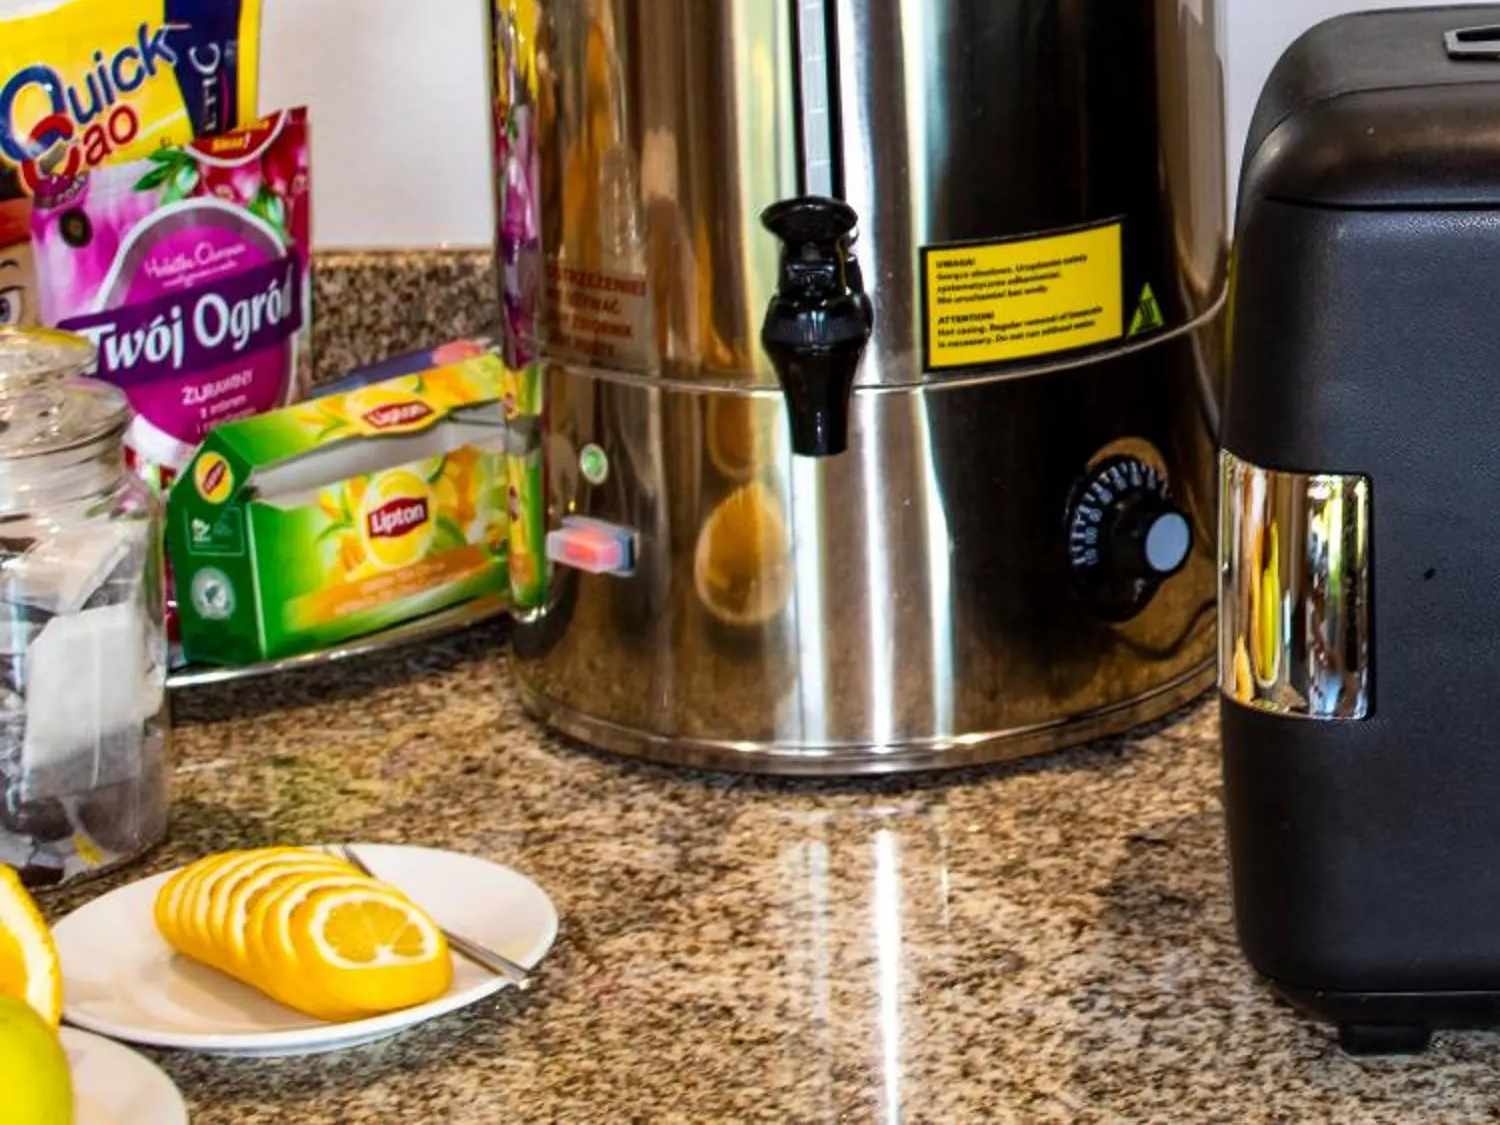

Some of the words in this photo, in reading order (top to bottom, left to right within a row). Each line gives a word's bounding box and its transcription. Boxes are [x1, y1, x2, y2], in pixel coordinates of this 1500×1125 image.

[0, 23, 188, 162] Quick
[77, 305, 185, 375] Twój
[371, 503, 425, 534] Lipton
